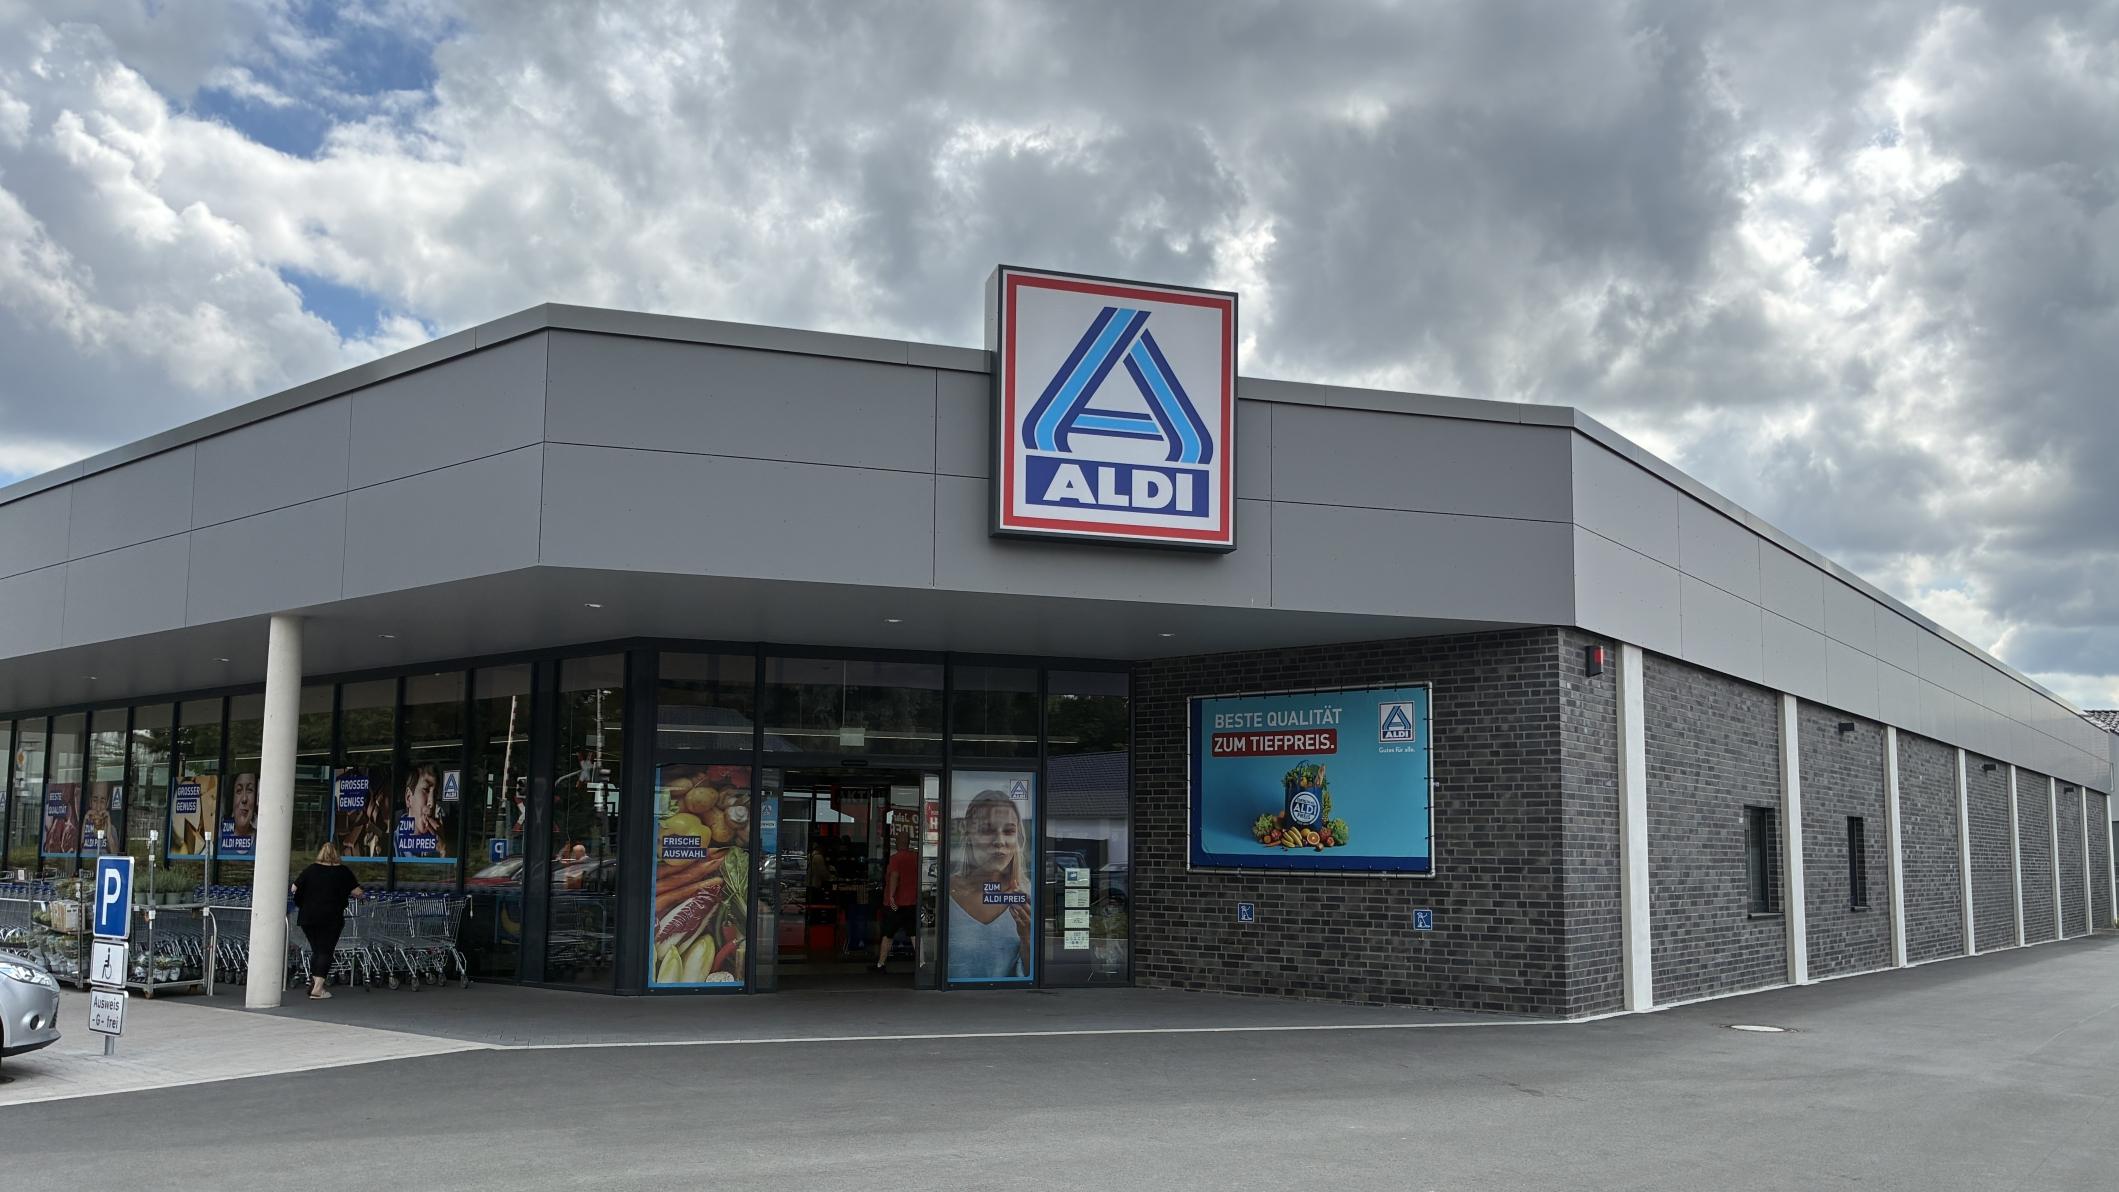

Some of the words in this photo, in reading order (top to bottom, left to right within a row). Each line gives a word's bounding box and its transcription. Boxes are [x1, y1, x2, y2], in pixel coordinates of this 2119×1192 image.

[1042, 463, 1194, 512] ALDI
[1215, 712, 1262, 728] BESTE
[1267, 705, 1342, 727] QUALITÄT
[1214, 737, 1246, 752] ZUM
[1250, 734, 1335, 751] TIEFPREIS.
[340, 779, 369, 790] GROSSER
[177, 786, 200, 796] GROSSER
[176, 801, 196, 811] GENUSS
[339, 797, 364, 808] GENUSS
[1293, 803, 1317, 816] ALDI
[223, 823, 235, 832] ZUM
[400, 820, 414, 831] ZUM
[222, 838, 234, 848] ALDI
[235, 838, 251, 848] PREIS
[399, 838, 414, 849] ALDI
[416, 838, 436, 849] PREIS
[663, 837, 700, 846] FRISCHE
[663, 850, 706, 858] AUSWAHL
[101, 868, 121, 926] P
[93, 995, 120, 1011] Ausweis
[106, 1015, 119, 1029] frei
